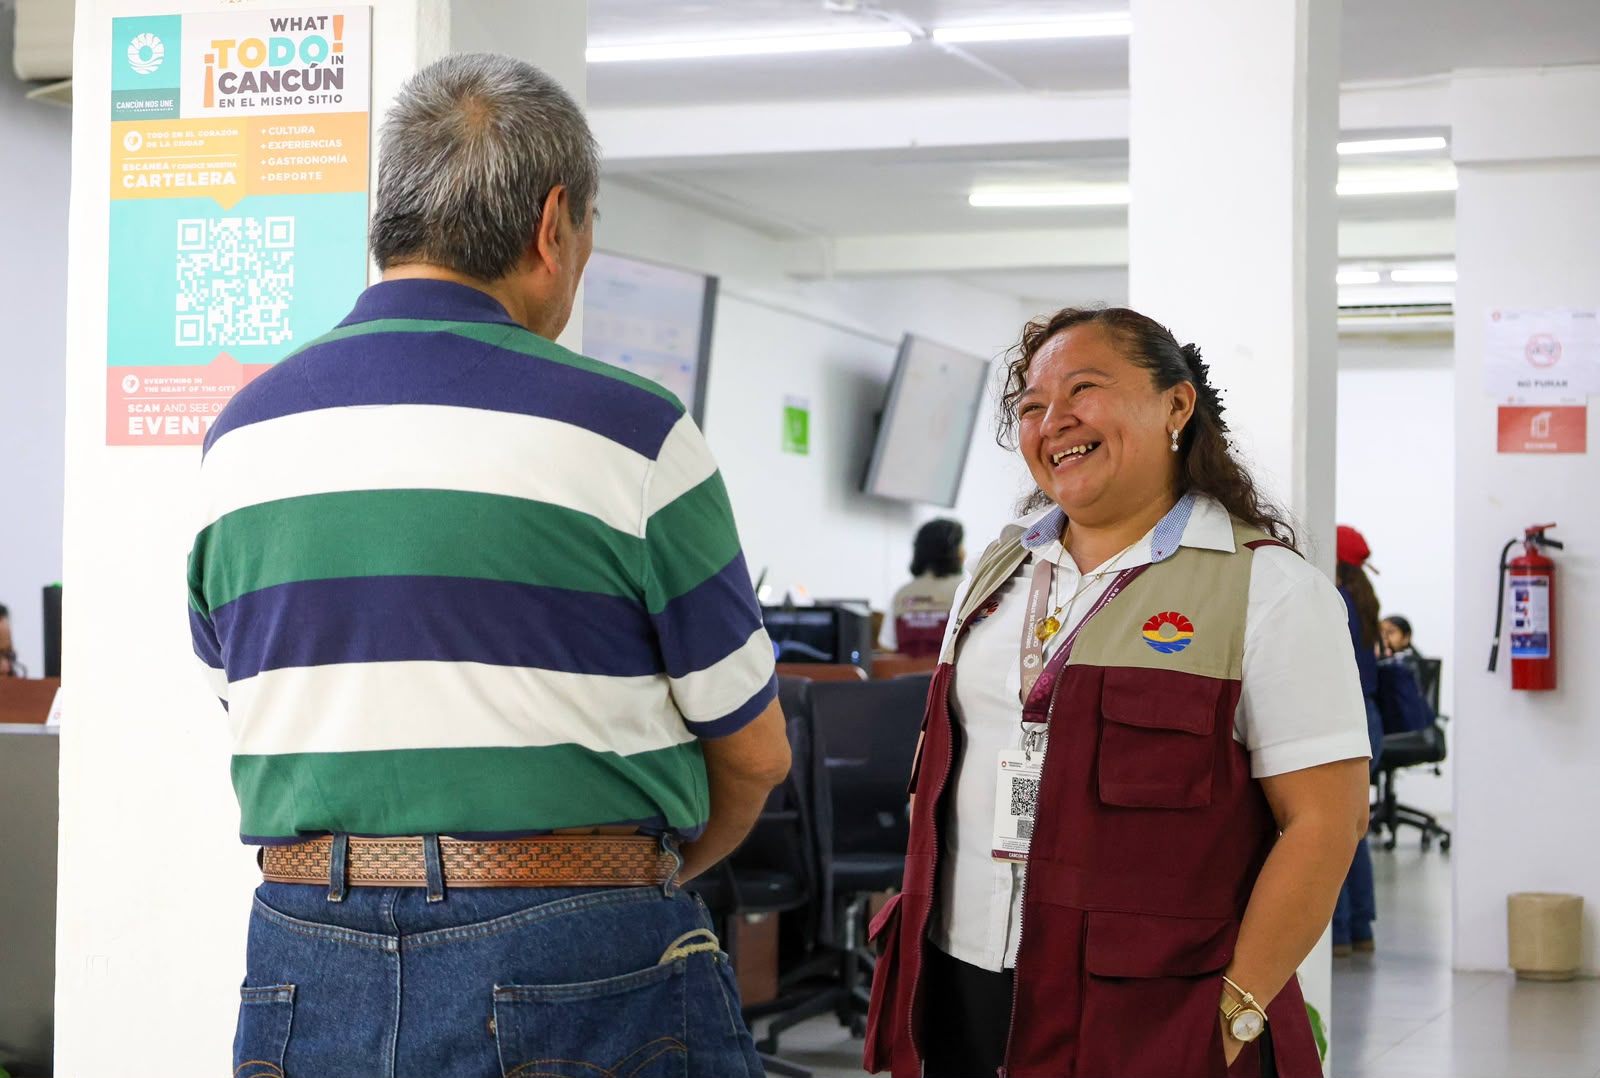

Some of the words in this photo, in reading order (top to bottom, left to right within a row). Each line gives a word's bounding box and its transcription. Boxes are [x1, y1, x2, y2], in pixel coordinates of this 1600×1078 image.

[270, 16, 328, 32] WHAT
[331, 55, 344, 65] IN
[218, 62, 344, 95] CANCÚN
[145, 100, 159, 108] NOS
[160, 99, 174, 107] UNE
[219, 98, 235, 108] EN
[240, 98, 255, 107] EL
[260, 96, 303, 106] MISMO
[308, 94, 343, 104] SITIO
[147, 131, 170, 139] TODO
[268, 125, 316, 136] CULTURA
[268, 139, 343, 150] EXPERIENCIAS
[268, 152, 348, 166] GASTRONOMÍA
[122, 162, 169, 171] ESCANEA
[122, 170, 237, 189] CARTELERA
[268, 171, 323, 181] DEPORTE
[144, 377, 192, 385] EVERYTHING
[144, 385, 159, 393] THE
[161, 385, 186, 393] HEART
[127, 403, 160, 413] SCAN
[162, 403, 187, 413] AND
[189, 403, 209, 413] SEE
[128, 415, 217, 435] EVENT
